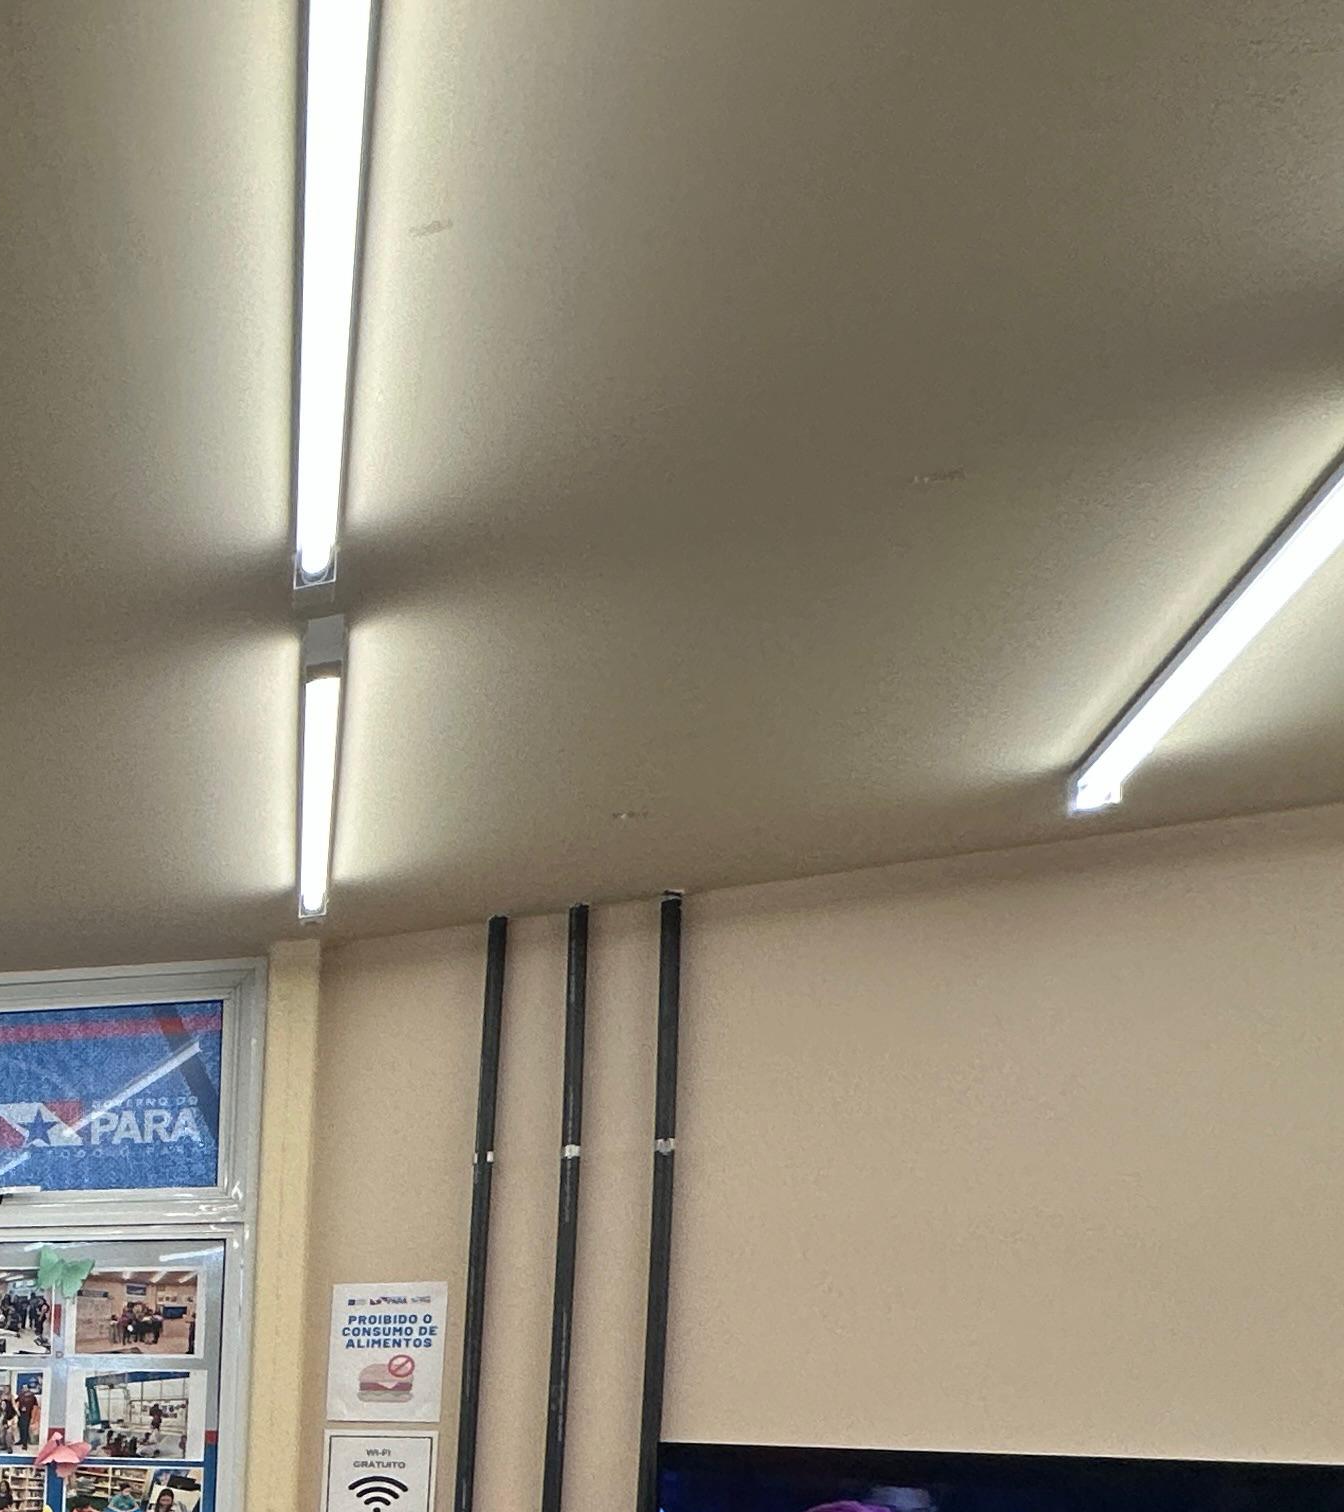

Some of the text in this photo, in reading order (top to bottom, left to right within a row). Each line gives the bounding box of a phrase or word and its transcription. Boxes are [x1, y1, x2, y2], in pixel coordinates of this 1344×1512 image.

[348, 1313, 433, 1326] PROIBIDO O
[341, 1325, 438, 1337] CONSUMO DE
[345, 1337, 433, 1349] ALIMENTOS
[352, 1460, 406, 1470] GRATUITO
